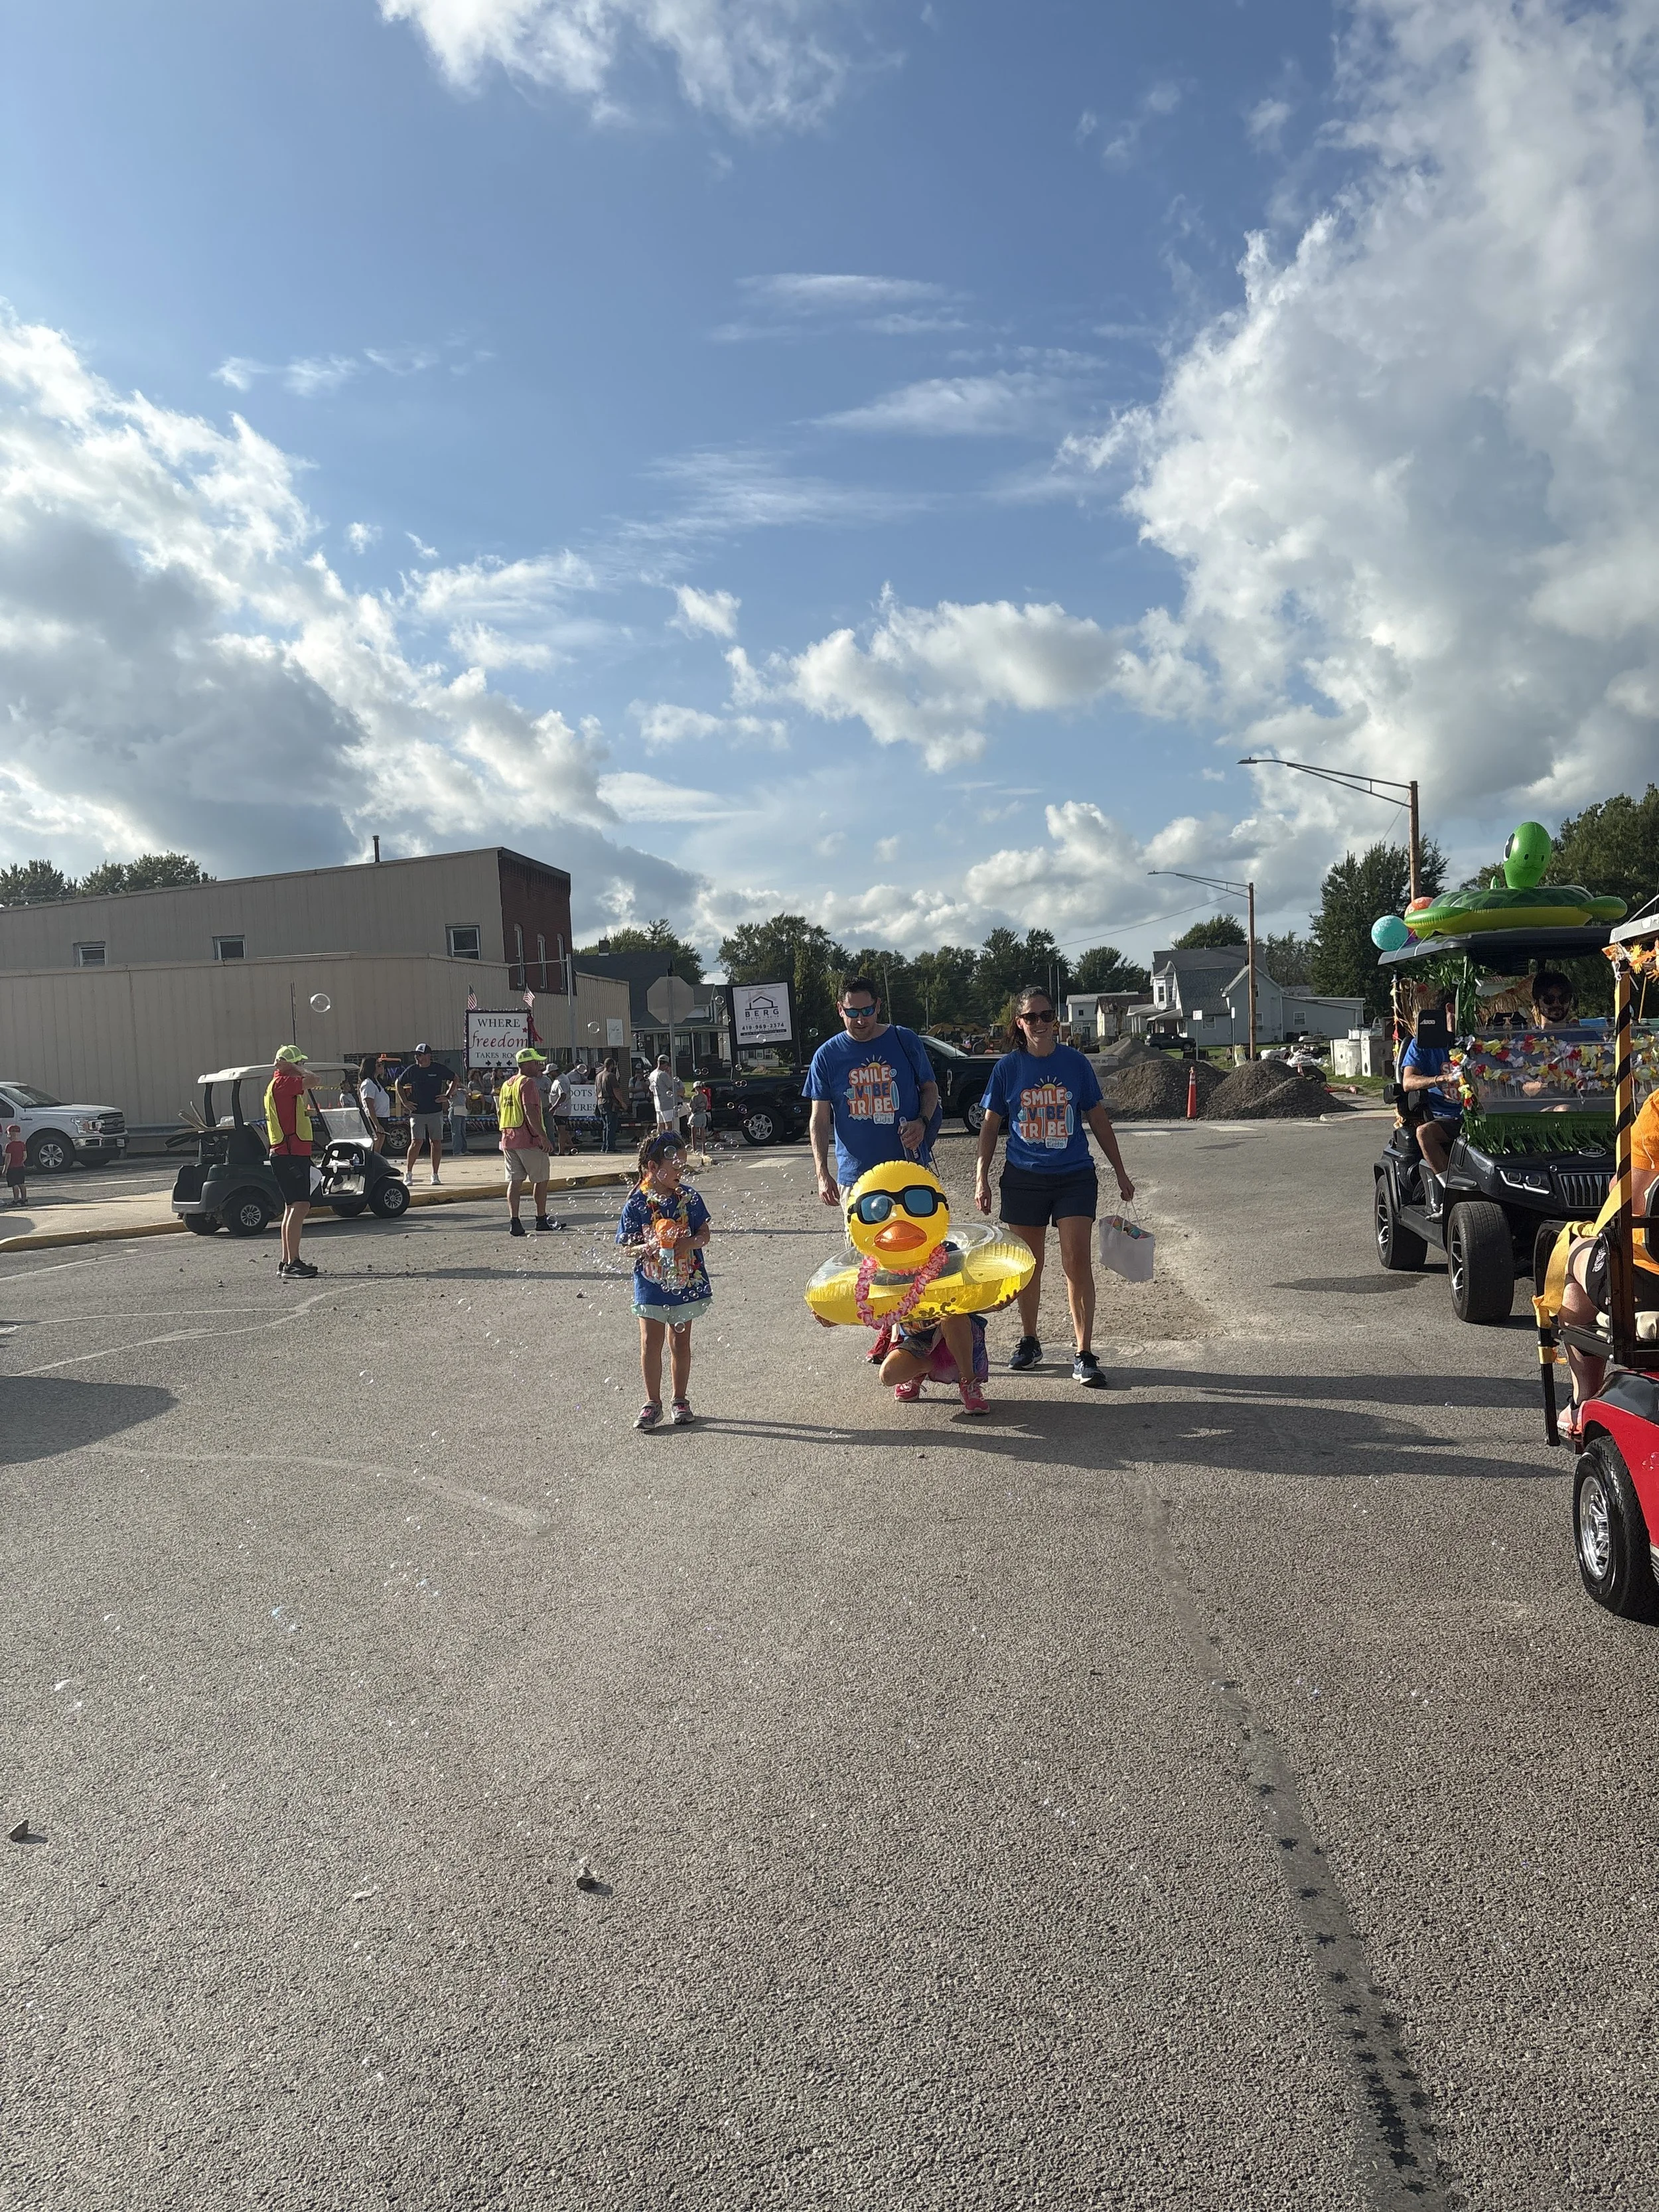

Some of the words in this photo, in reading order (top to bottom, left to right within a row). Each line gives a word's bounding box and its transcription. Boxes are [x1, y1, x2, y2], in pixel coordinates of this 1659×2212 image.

[745, 1009, 779, 1017] BERG
[477, 1018, 521, 1028] WHERE
[469, 1030, 528, 1049] freedom
[850, 1067, 890, 1084] SMILE
[1023, 1088, 1066, 1106] SMILE
